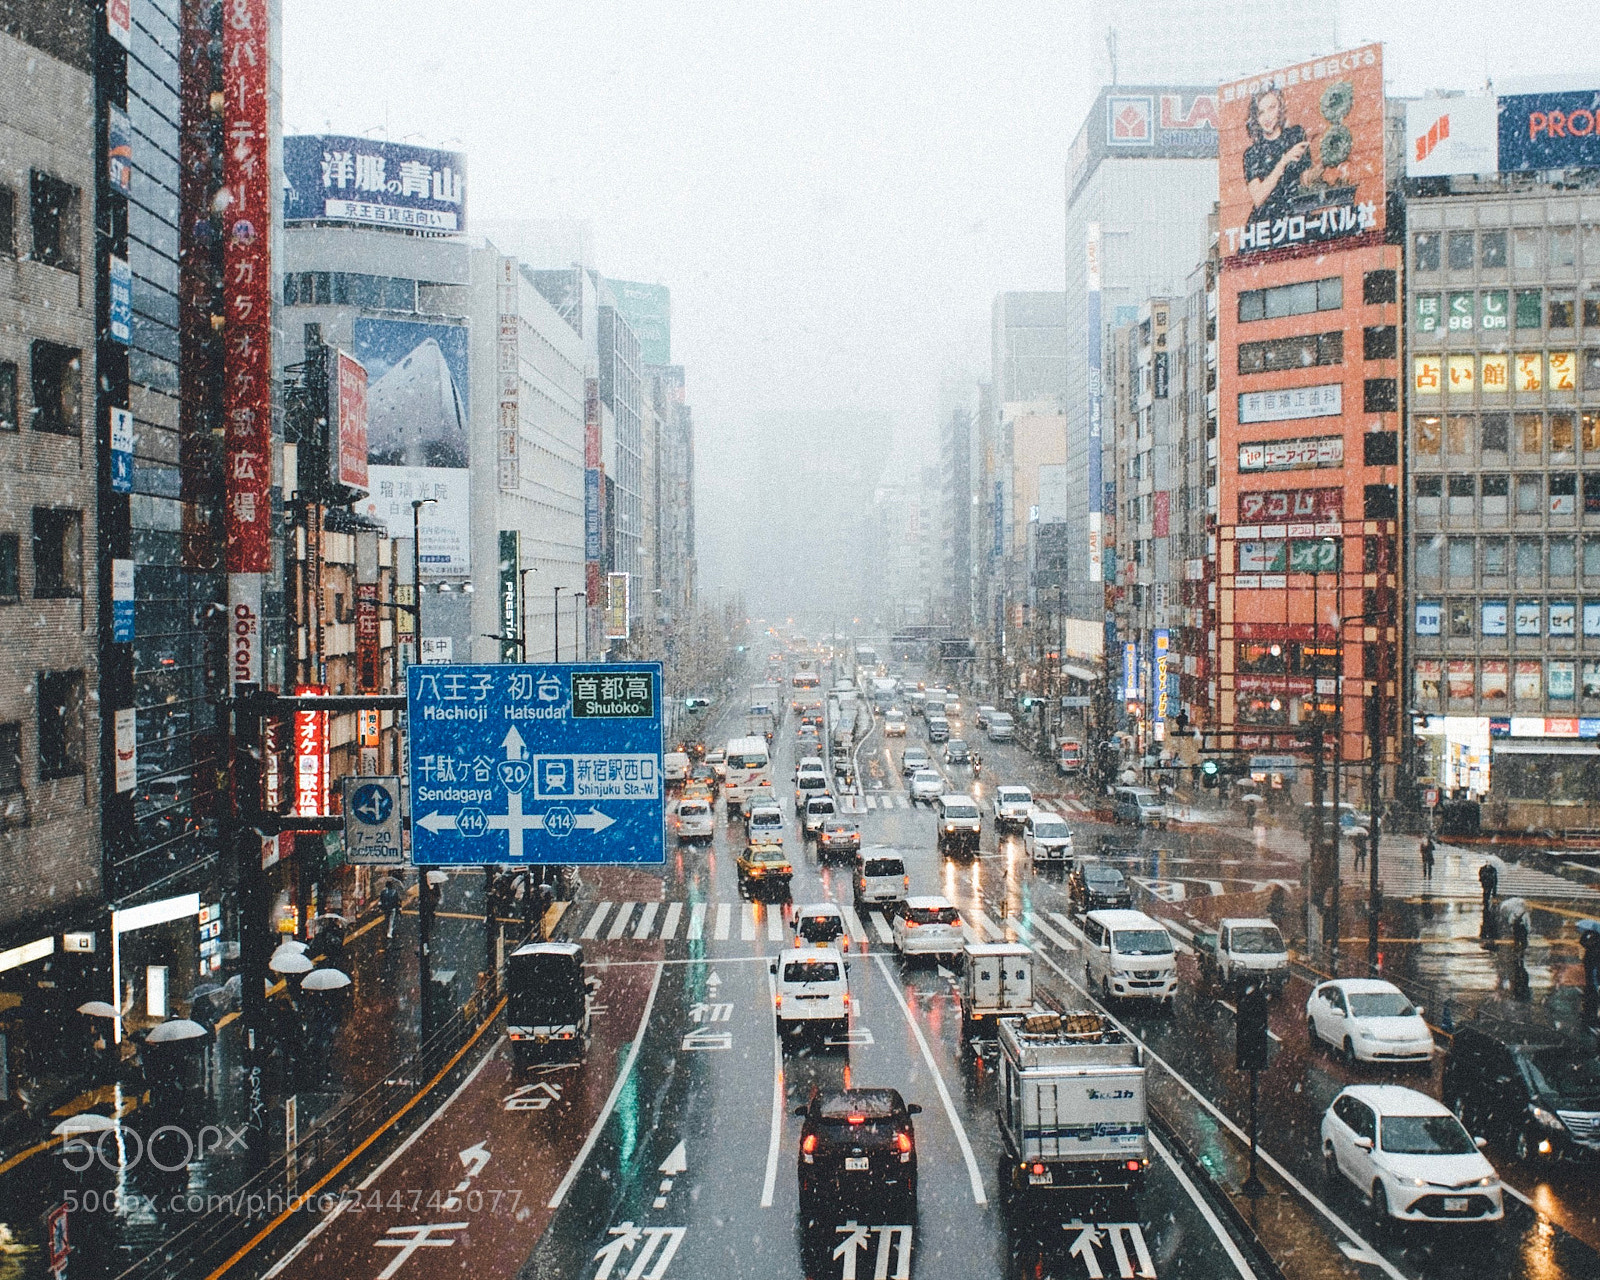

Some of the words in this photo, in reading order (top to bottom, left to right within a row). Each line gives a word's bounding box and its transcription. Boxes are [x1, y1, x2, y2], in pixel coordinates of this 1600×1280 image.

[321, 151, 462, 203] 洋服の青山
[345, 203, 441, 224] 京王百貨店向い
[1225, 200, 1376, 250] THEグローバル社
[1419, 296, 1501, 314] ほぐし
[1417, 364, 1505, 388] 占い館
[416, 674, 494, 701] 八王子
[508, 673, 562, 701] 初台
[576, 678, 649, 700] 首都高
[504, 706, 566, 720] Hatsudai
[586, 702, 640, 715] Shutoko
[505, 767, 524, 782] 20
[577, 759, 654, 781] 新宿駅西口
[418, 786, 492, 803] Sendagaya
[578, 784, 620, 797] Shinjuku
[460, 814, 484, 829] 414
[548, 814, 571, 829] 414
